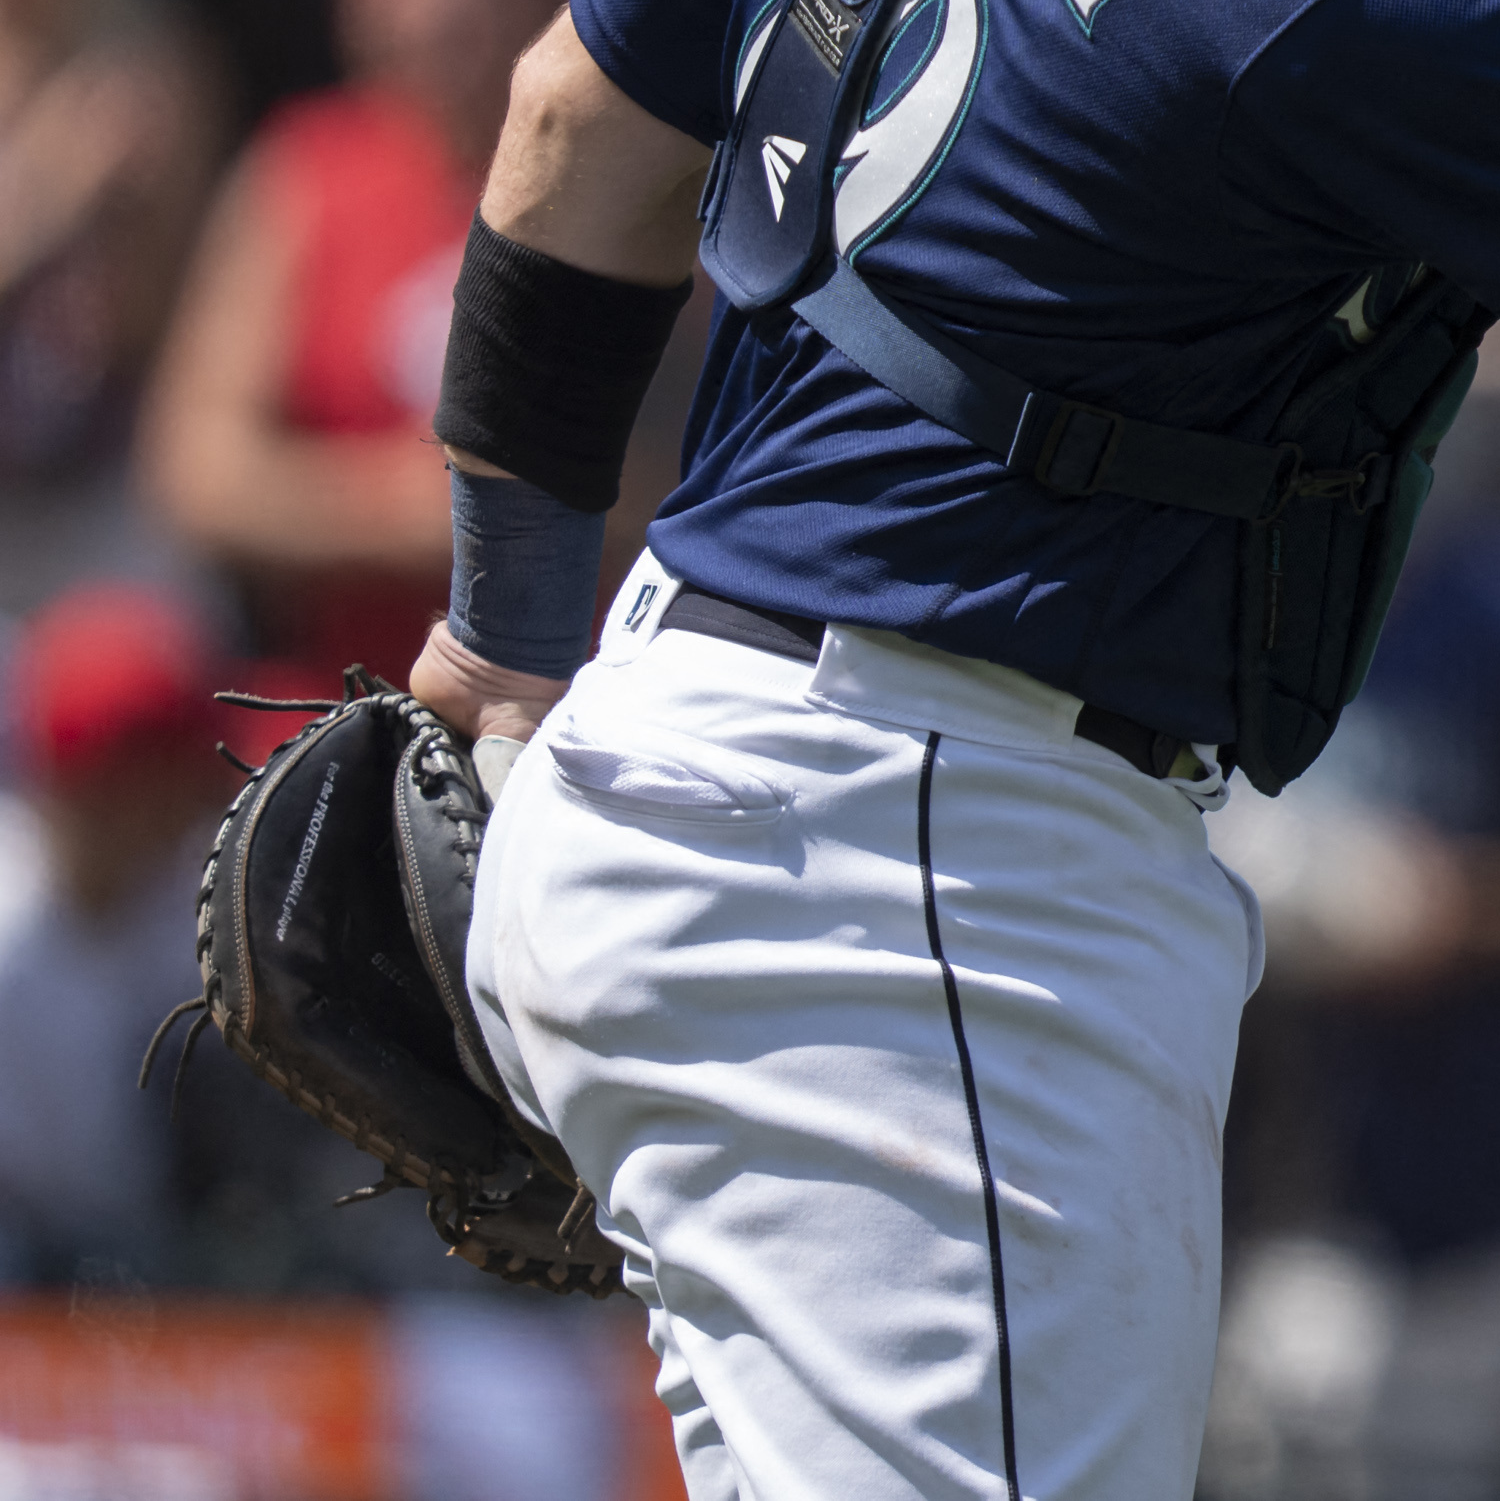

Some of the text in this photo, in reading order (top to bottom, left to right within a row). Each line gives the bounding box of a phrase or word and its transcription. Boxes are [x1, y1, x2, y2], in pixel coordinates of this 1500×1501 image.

[319, 780, 334, 802] the
[284, 797, 329, 907] PROFESSIONAL
[275, 903, 293, 943] player
